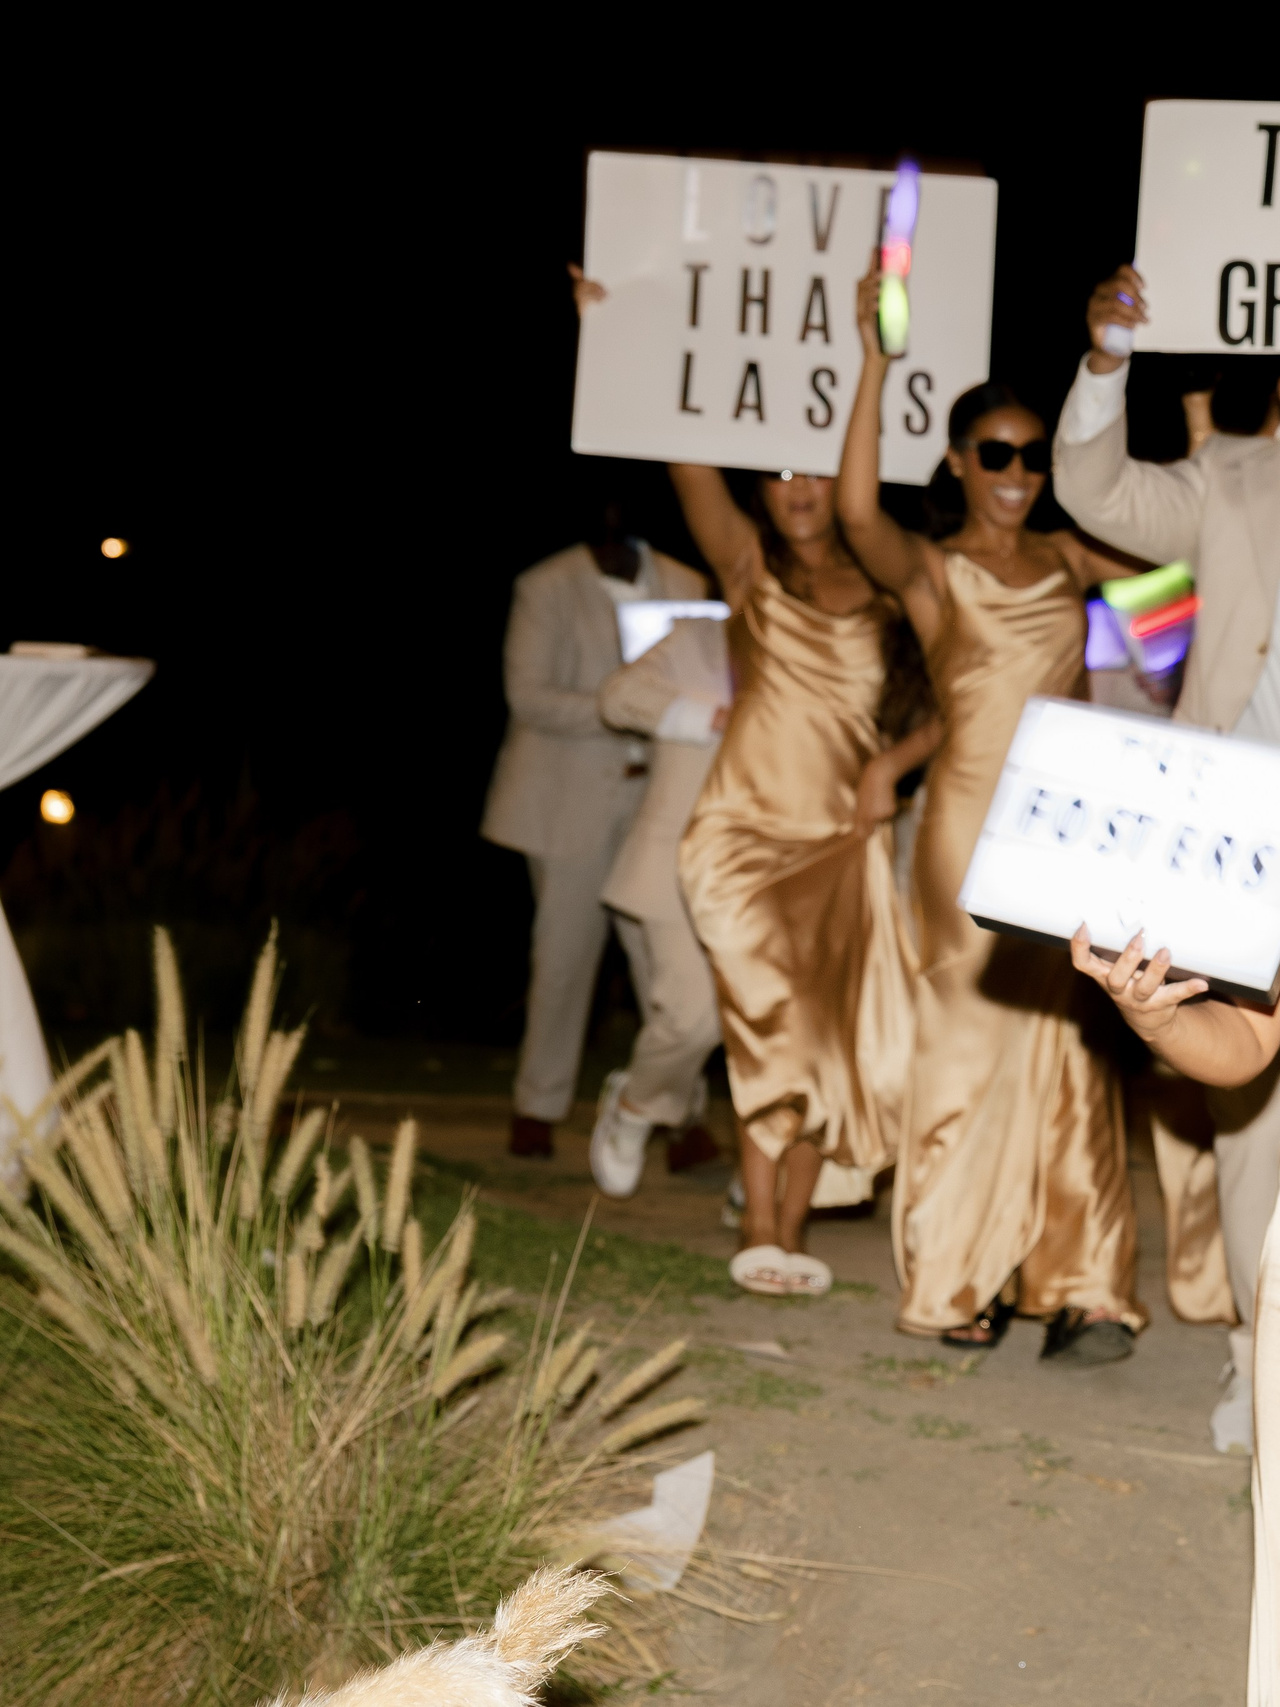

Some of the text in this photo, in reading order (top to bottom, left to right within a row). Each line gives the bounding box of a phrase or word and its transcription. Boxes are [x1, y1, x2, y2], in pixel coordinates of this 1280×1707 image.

[684, 263, 831, 345] THA
[678, 352, 933, 437] LASS
[1017, 786, 1277, 890] FOSTERS
